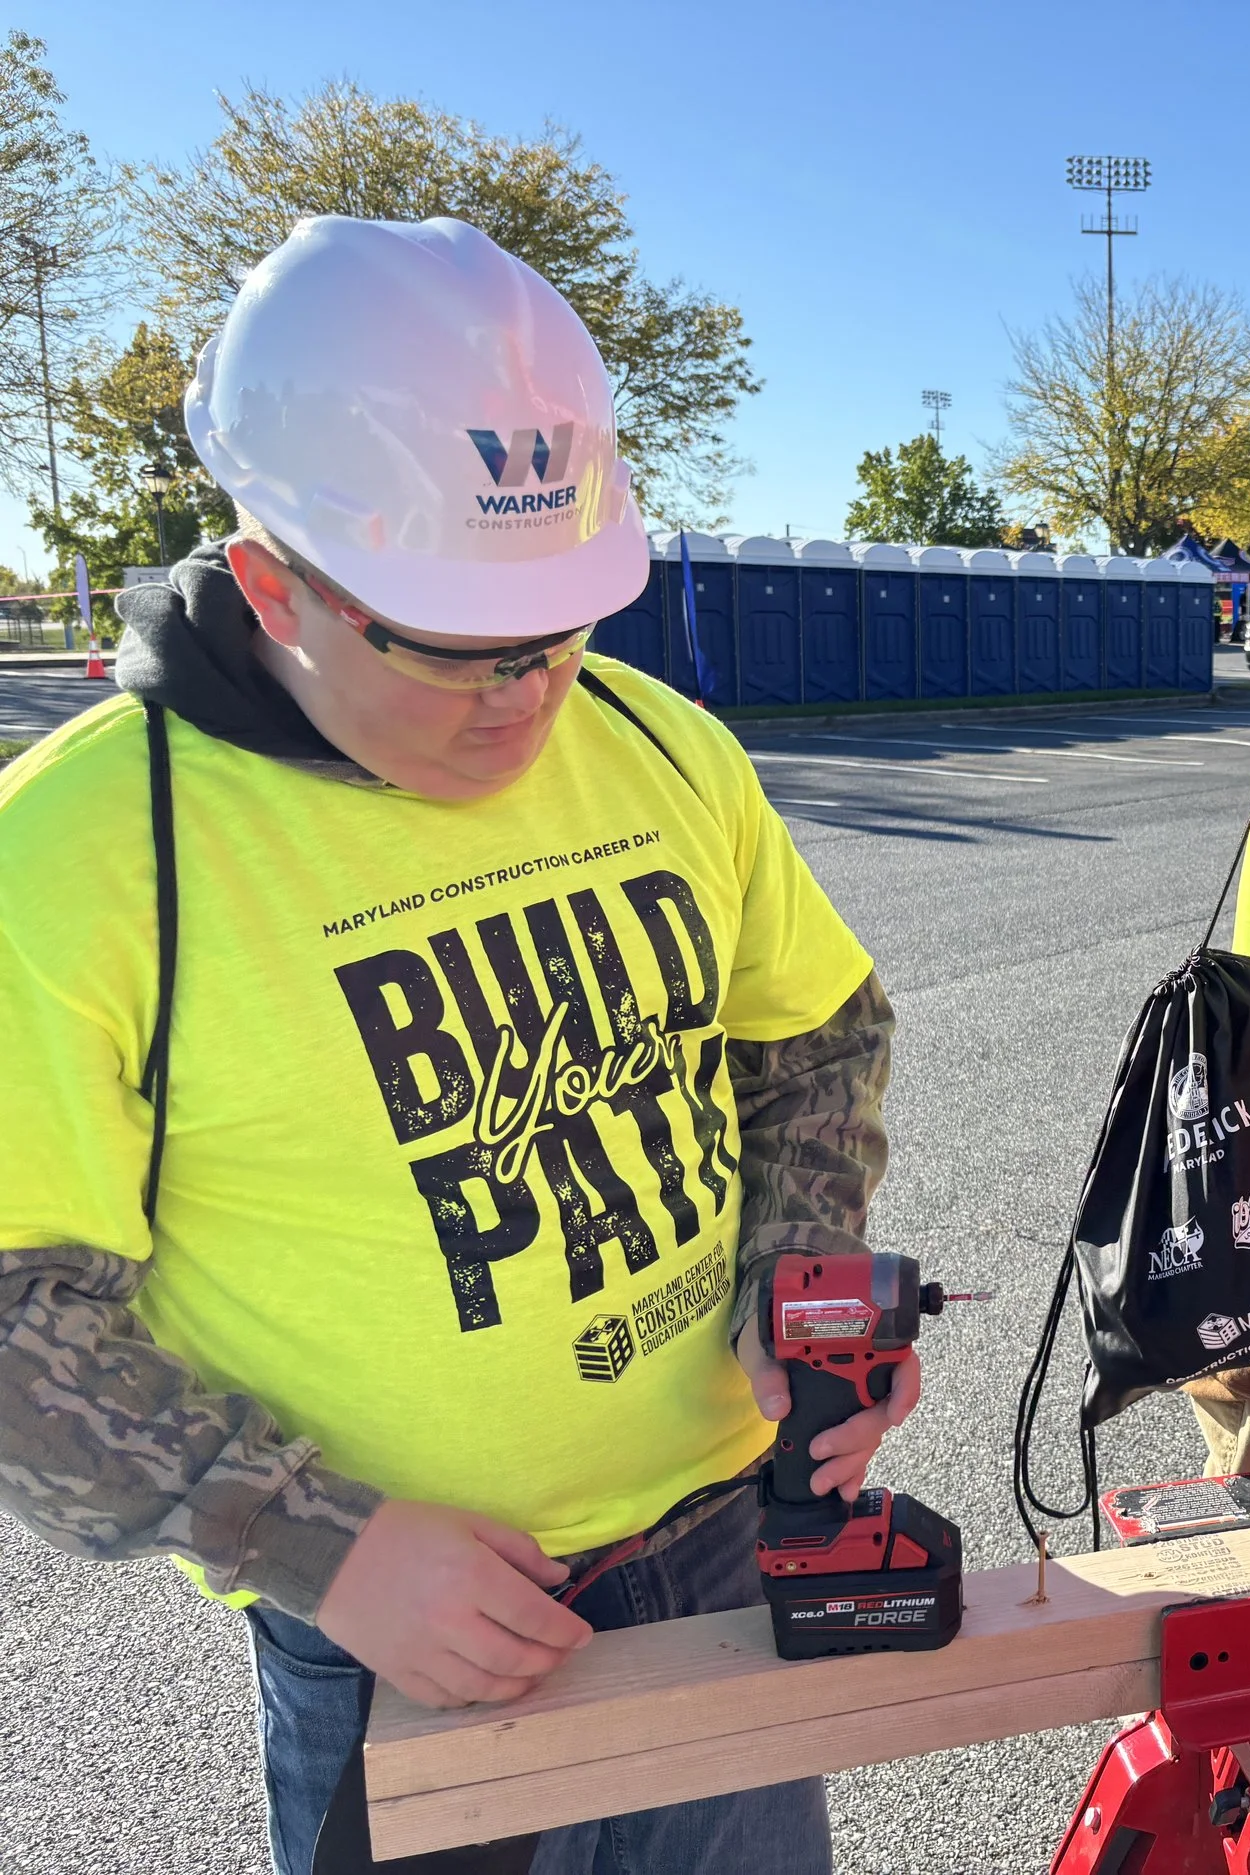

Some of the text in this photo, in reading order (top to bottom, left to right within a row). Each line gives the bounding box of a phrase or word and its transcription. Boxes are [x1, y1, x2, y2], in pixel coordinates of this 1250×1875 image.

[476, 486, 577, 515] WARNER
[466, 506, 583, 530] CONSTRUCTION
[323, 830, 661, 938] MARYLAND CONSTRUCTION CAREER DAY
[333, 870, 720, 1145] BUILD
[477, 1002, 682, 1184] Your
[1172, 1149, 1225, 1175] MARYLAD
[1148, 1239, 1202, 1274] NECA
[1174, 1261, 1204, 1275] CHAPTER
[632, 1240, 724, 1316] MARYLAND CENTER FOR
[635, 1255, 728, 1340] CONSTRUCTION
[641, 1315, 690, 1357] EDUCATION
[1179, 1538, 1225, 1552] STUD
[790, 1597, 936, 1620] XC6.0 M18 REDLITHIUM
[854, 1609, 928, 1627] FORGE
